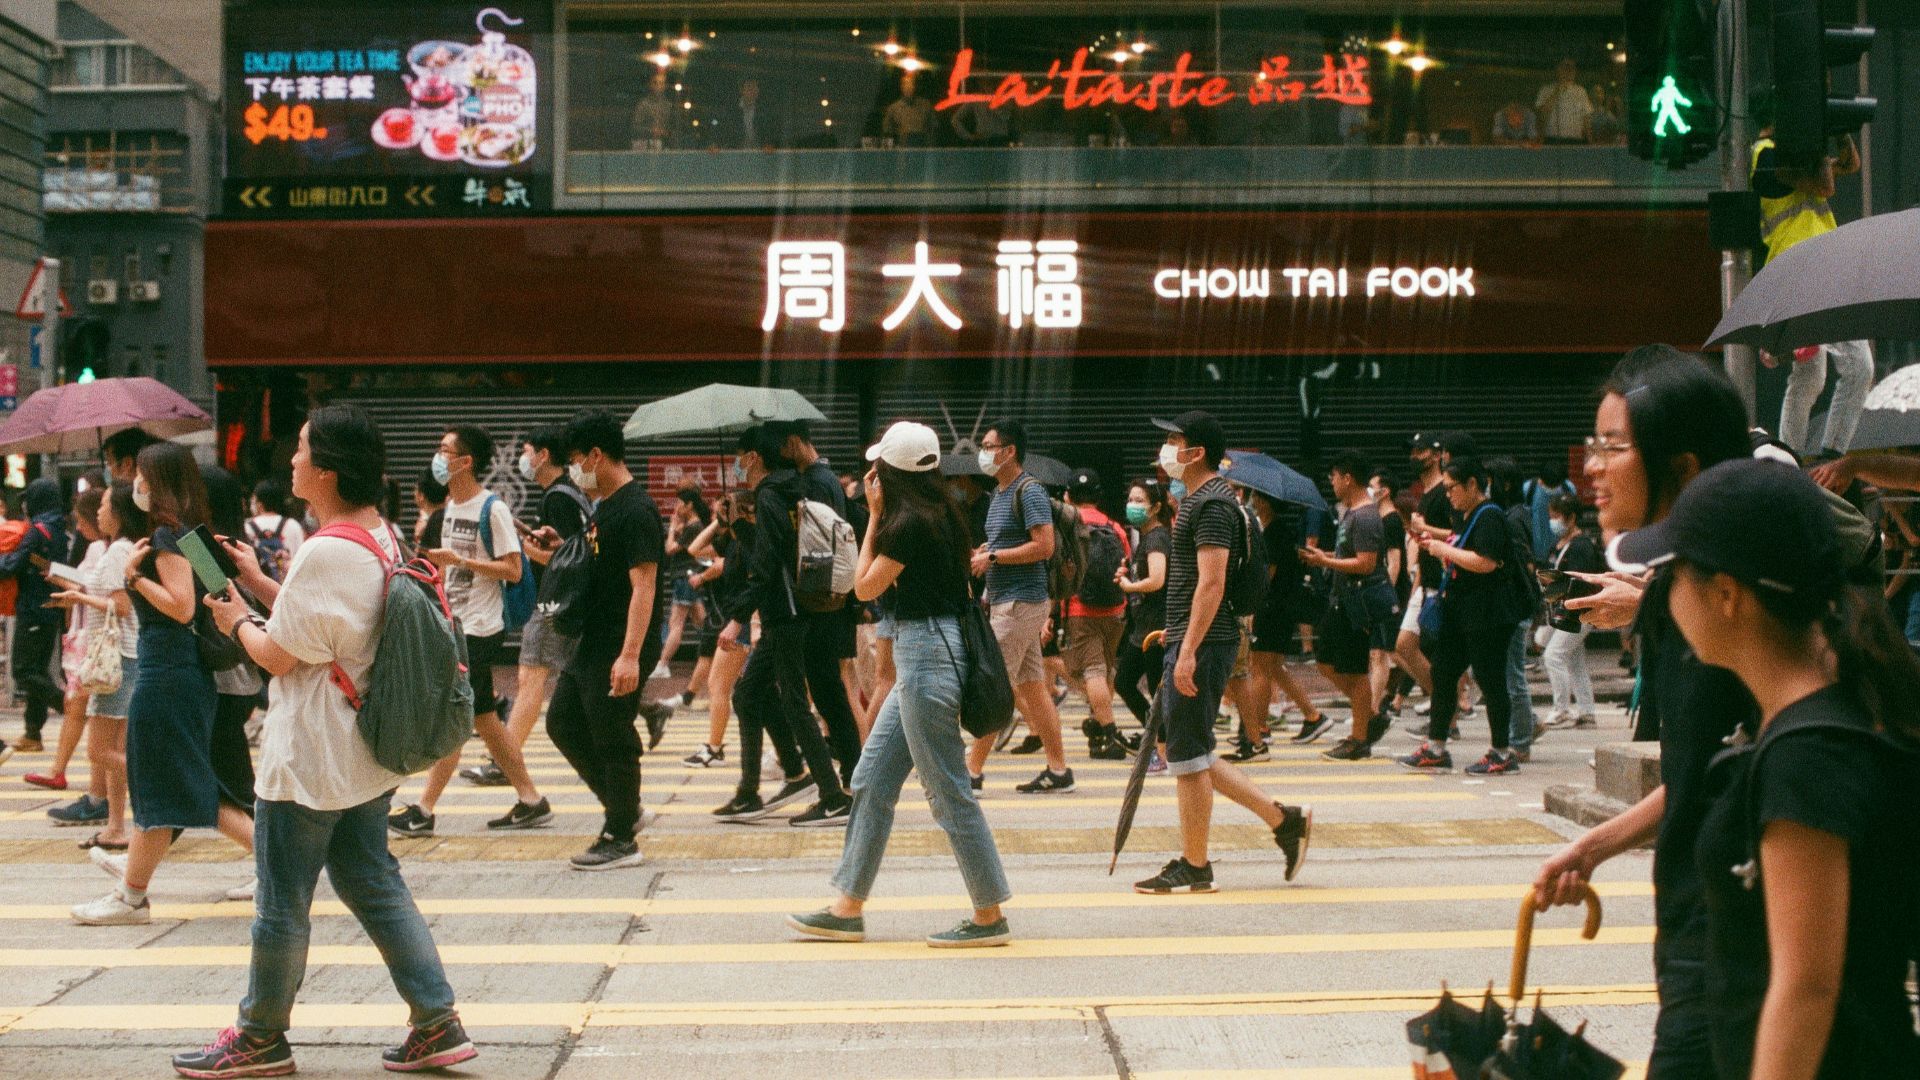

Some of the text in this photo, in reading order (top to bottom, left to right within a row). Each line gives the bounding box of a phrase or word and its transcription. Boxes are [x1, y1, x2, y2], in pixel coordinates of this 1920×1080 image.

[243, 50, 401, 72] ENJOY YOUR TEA TIME
[935, 47, 1235, 111] La'taste
[1247, 54, 1373, 105] 品越
[244, 75, 375, 100] 下午茶套餐
[761, 240, 1082, 332] 周大福
[1154, 267, 1475, 298] CHOW TAI FOOK
